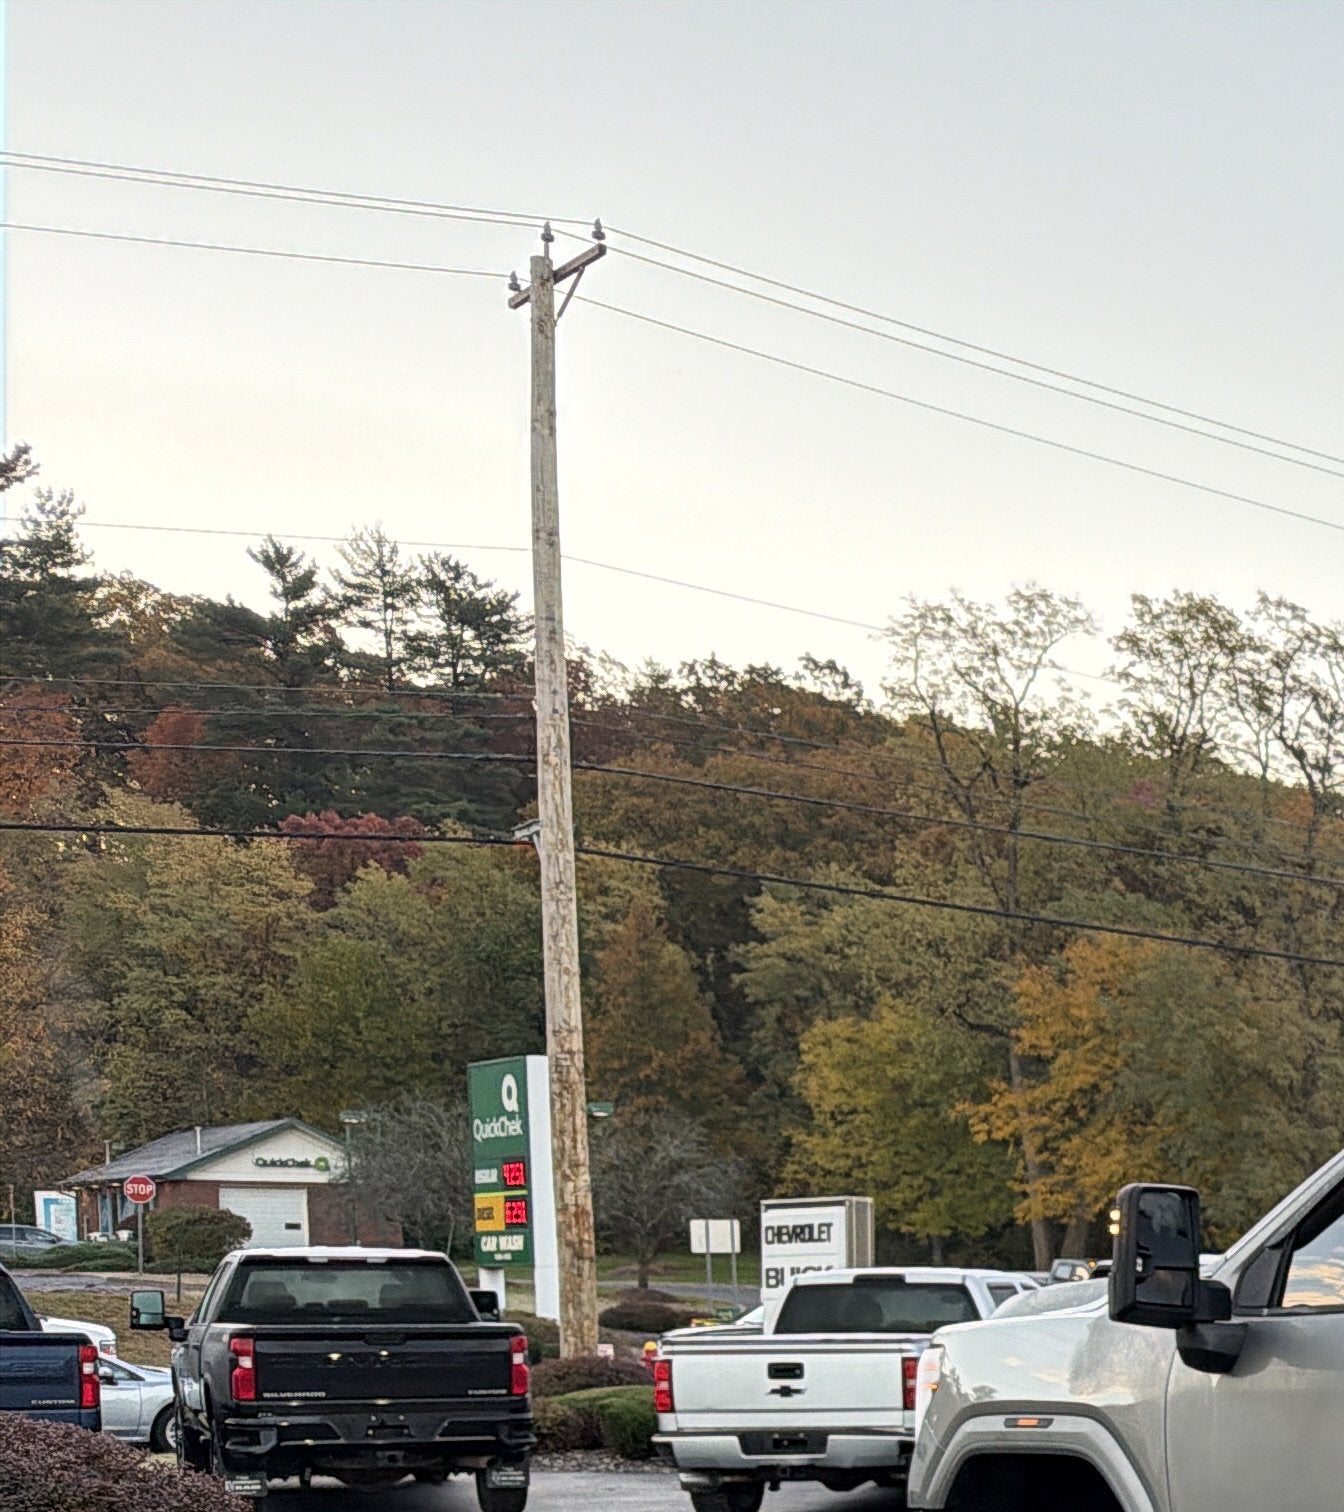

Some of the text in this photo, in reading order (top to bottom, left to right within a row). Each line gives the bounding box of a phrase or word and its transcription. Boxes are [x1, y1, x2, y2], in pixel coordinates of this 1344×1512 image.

[502, 1073, 519, 1113] Q
[473, 1113, 523, 1142] QuickChek
[126, 1183, 154, 1196] STOP
[481, 1234, 524, 1252] CAR WASH
[765, 1222, 834, 1245] CHEVROLET
